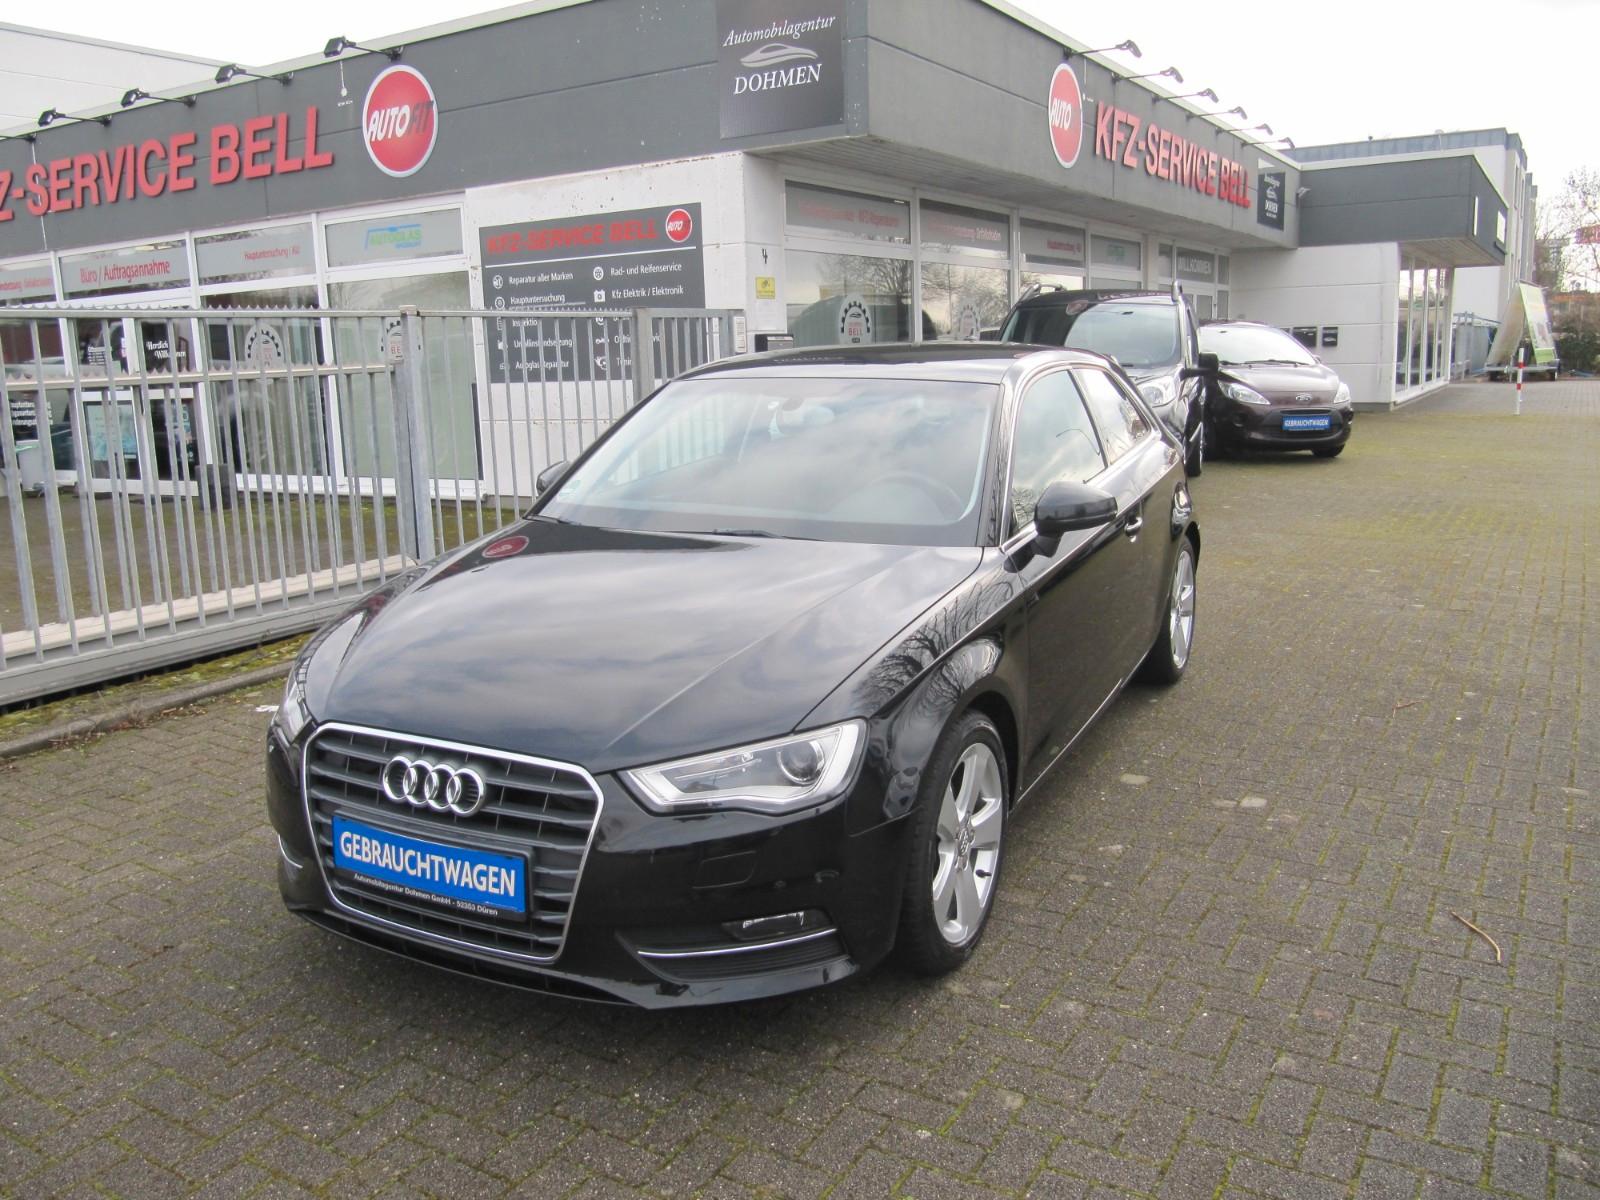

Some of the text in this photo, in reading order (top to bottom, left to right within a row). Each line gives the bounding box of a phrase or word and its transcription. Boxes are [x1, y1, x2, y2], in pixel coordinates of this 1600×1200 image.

[723, 16, 836, 47] Automobilagentur
[734, 63, 822, 95] DOHMEN
[210, 105, 334, 186] BELL
[1095, 100, 1251, 209] KFZ-SERVICE BELL
[487, 219, 659, 253] KFZ-SERVICE BELL
[80, 267, 98, 284] Büro
[103, 260, 171, 283] Auftragsannahme
[508, 276, 537, 287] Reparatur
[550, 271, 574, 281] Marken
[610, 262, 682, 276] Rad- und Reifenservice
[510, 293, 566, 306] Hauptuntersuchung
[611, 289, 622, 299] Kfz
[623, 287, 647, 298] Elektrik
[651, 285, 685, 296] Elektronik
[1284, 419, 1329, 427] GEBRAUCHTWAGEN
[340, 831, 516, 897] GEBRAUCHTWAGEN
[353, 873, 404, 893] Automobilagentur
[405, 887, 431, 900] Dohmen
[431, 894, 451, 906] GmbH
[476, 904, 498, 916] Düren
